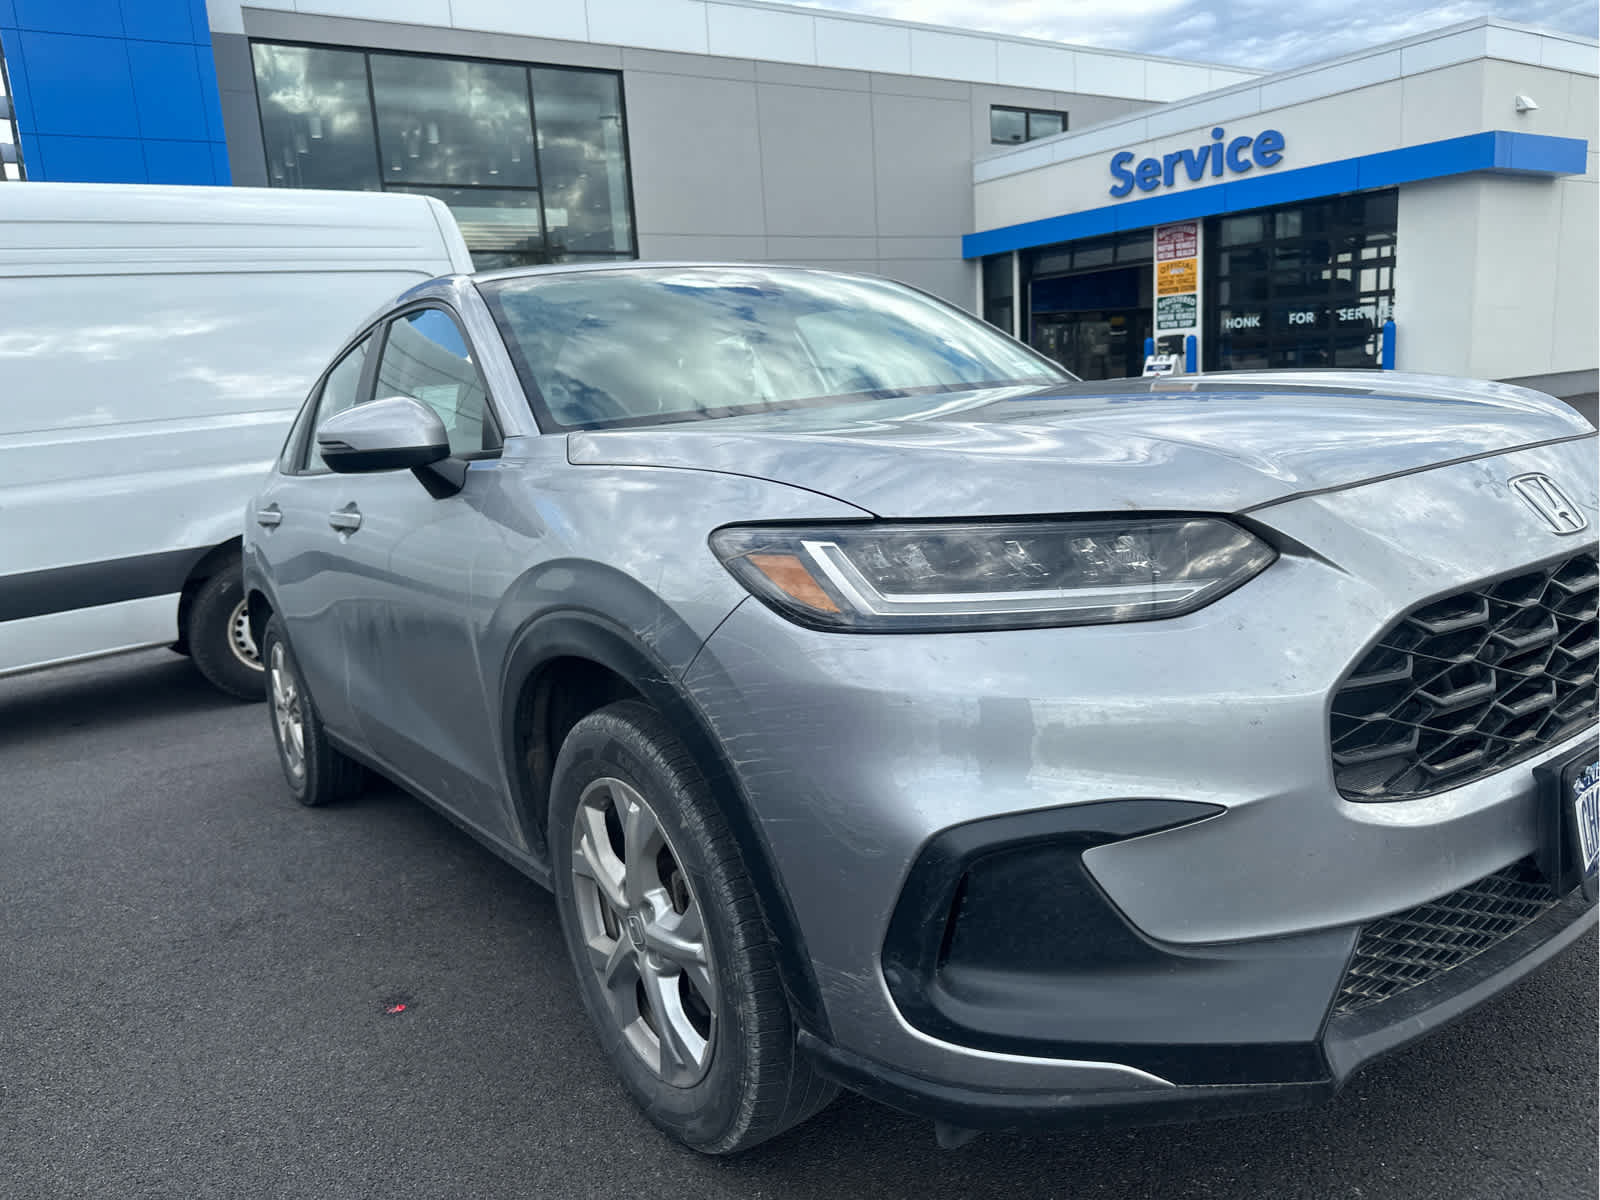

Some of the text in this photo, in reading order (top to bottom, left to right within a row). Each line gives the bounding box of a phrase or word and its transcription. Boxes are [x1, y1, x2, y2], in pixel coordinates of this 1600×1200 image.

[1109, 127, 1285, 198] Service
[1159, 261, 1193, 273] OFFICIAL
[1159, 296, 1195, 308] REGISTERED
[1225, 316, 1261, 329] HONK
[1288, 311, 1315, 325] FOR
